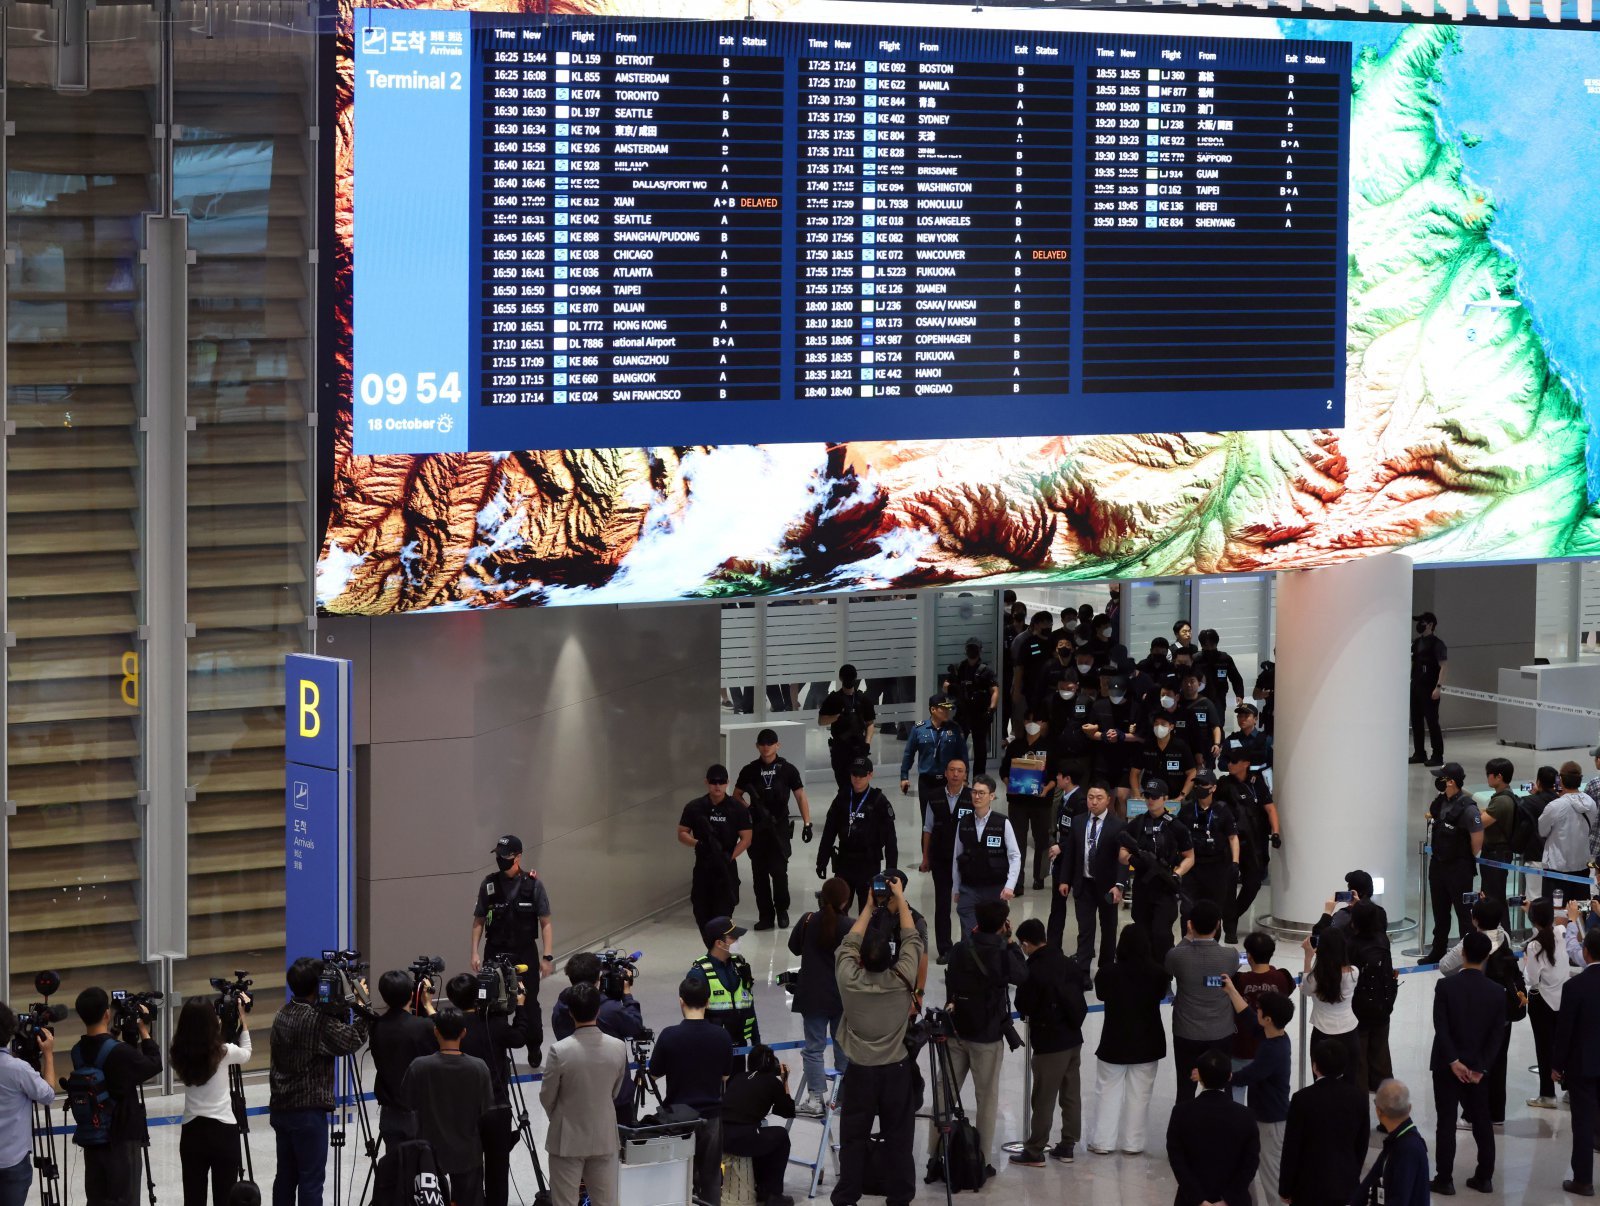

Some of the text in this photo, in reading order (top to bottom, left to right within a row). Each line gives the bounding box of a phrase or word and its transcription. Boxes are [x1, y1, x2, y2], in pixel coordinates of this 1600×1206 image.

[390, 31, 426, 54] 도착
[494, 29, 767, 47] Time New Flight From Exit Status
[430, 46, 462, 56] Arrivals
[808, 39, 1059, 56] Time New Flight From Exit Status
[495, 52, 729, 67] 16:25 15:44 DL 159 DETROIT B
[1096, 48, 1326, 65] Time New Flight From Exit Status
[809, 61, 1024, 75] 17:25 17:14 KE 092 BOSTON B
[366, 70, 462, 90] Terminal 2
[615, 73, 669, 83] AMSTERDAM
[1097, 69, 1116, 78] 18:55
[1120, 70, 1140, 79] 18:55
[1162, 71, 1170, 80] LJ
[1171, 71, 1185, 80] 360
[1289, 75, 1294, 83] B
[919, 81, 949, 90] MANILA
[495, 88, 729, 102] 16:30 16:03 KE 074 TORONTO A
[615, 108, 652, 118] SEATTLE
[808, 112, 949, 124] 17:35 17:50 KE 402 SYDNEY
[494, 142, 668, 153] 16:40 15:58 KE 926 AMSTERDAM
[918, 167, 957, 175] BRISBANE
[1196, 170, 1218, 178] GUAM
[633, 181, 691, 190] DALLAS/FORT
[917, 183, 972, 192] WASHINGTON
[1196, 186, 1219, 195] TAIPEI
[614, 197, 778, 208] XIAN DELAYED
[917, 200, 963, 209] HONOLULU
[1196, 202, 1217, 211] HEFEI
[614, 215, 651, 224] SEATTLE
[917, 217, 970, 226] LOS ANGELES
[1094, 218, 1291, 227] 19:50 19:50 KE 834 SHENYANG A
[614, 231, 699, 243] SHANGHAI/PUDONG
[917, 233, 958, 242] NEW YORK
[494, 250, 727, 260] 16:50 16:28 KE 038 CHICAGO A
[916, 250, 1067, 260] VANCOUVER DELAYED
[614, 268, 653, 277] ATLANTA
[917, 267, 956, 276] FUKUOKA
[613, 285, 641, 295] TAIPEI
[916, 284, 946, 293] XIAMEN
[614, 303, 644, 312] DALIAN
[806, 302, 827, 311] 18:00
[832, 302, 853, 311] 18:00
[876, 301, 885, 310] LJ
[887, 301, 901, 310] 236
[916, 300, 946, 311] OSAKA/
[493, 320, 727, 331] 17:00 16:51 DL 7772 HONG KONG A
[916, 317, 946, 328] OSAKA/
[646, 337, 675, 348] Airport
[916, 334, 971, 344] COPENHAGEN
[613, 355, 669, 365] GUANGZHOU
[916, 351, 955, 361] FUKUOKA
[916, 368, 941, 377] HANOI
[613, 373, 656, 383] BANGKOK
[361, 371, 461, 405] 09 54
[805, 384, 953, 397] 18:40 18:40 LJ 862 QINGDAO
[493, 389, 726, 403] 17:20 17:14 KE 024 SAN FRANCISCO B
[1326, 399, 1333, 410] 2
[368, 417, 436, 431] 18 October
[299, 679, 321, 738] B
[294, 819, 307, 835] 도착
[294, 836, 315, 850] Arrivals
